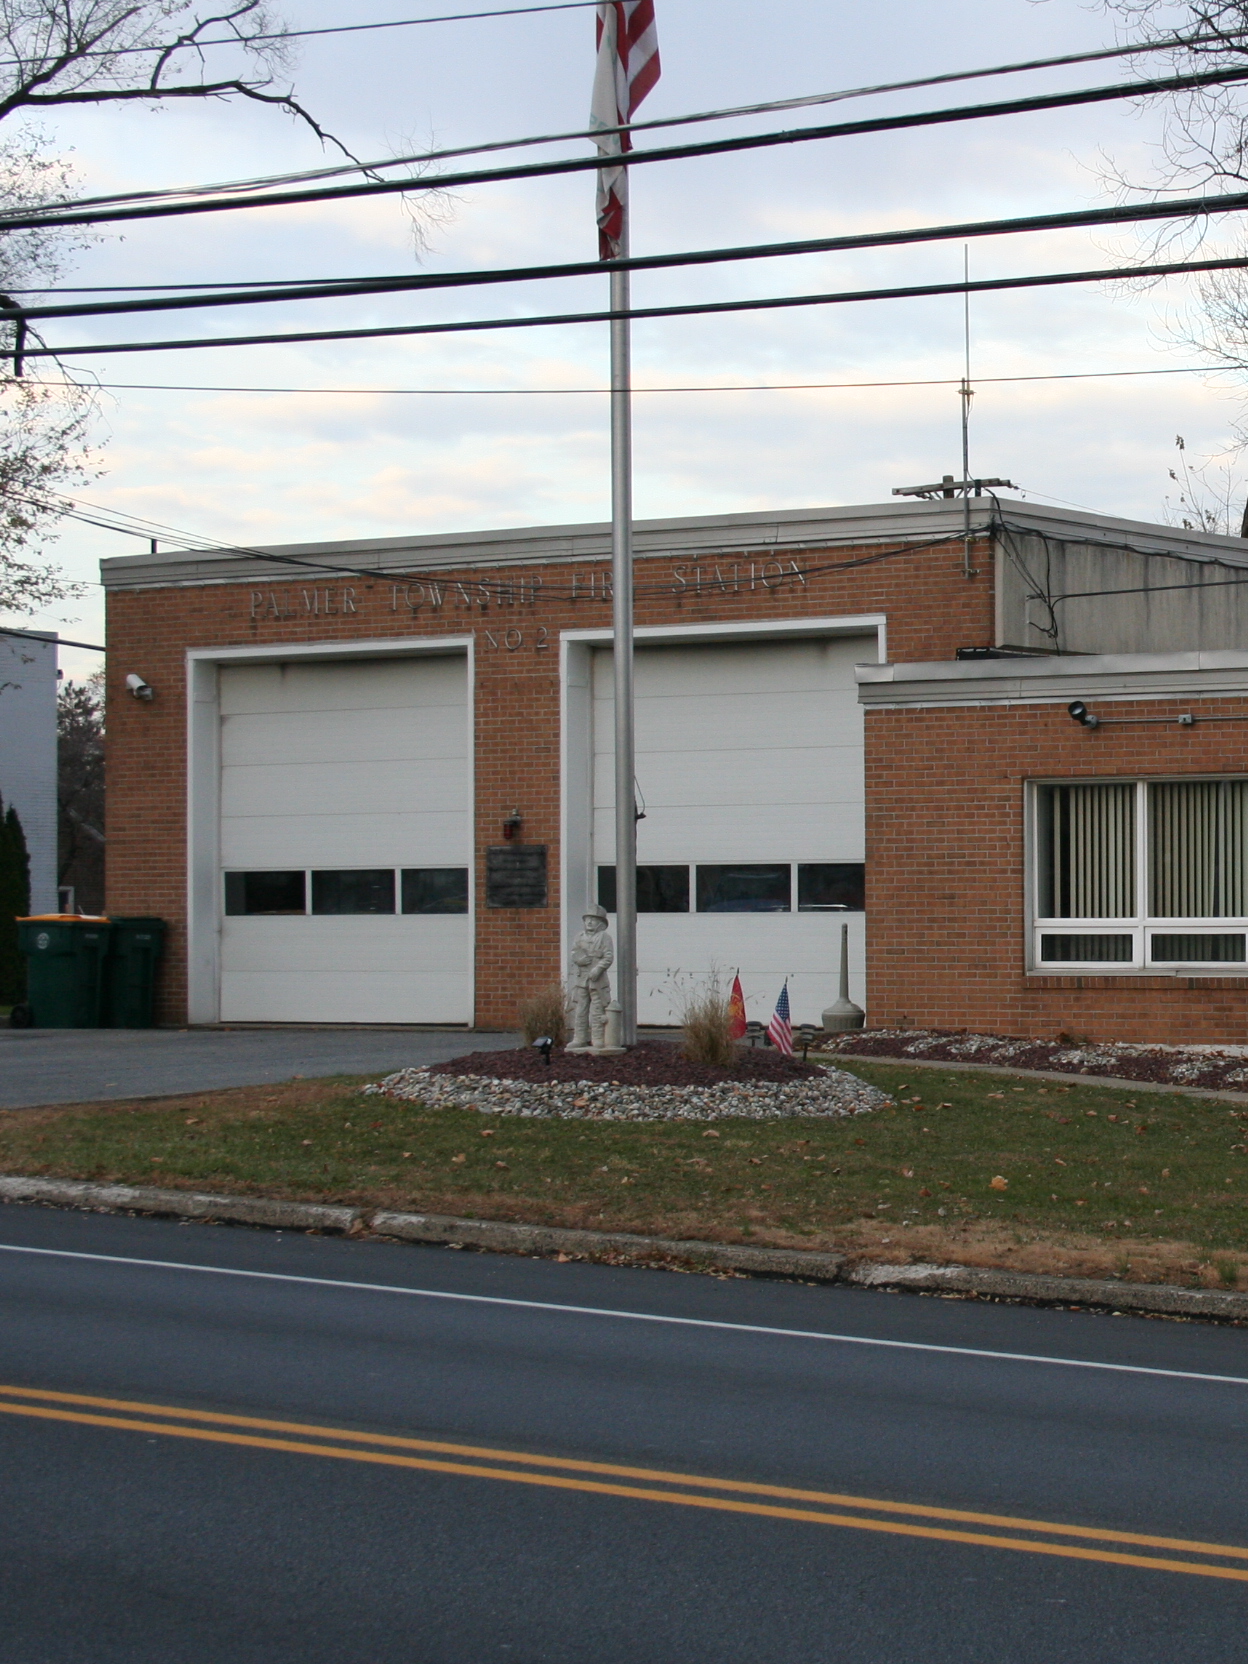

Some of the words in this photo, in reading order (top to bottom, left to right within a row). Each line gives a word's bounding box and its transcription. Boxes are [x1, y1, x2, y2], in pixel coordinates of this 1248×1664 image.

[250, 587, 358, 618] PALMER
[389, 576, 543, 611] TOWNSHIP
[572, 572, 615, 600] FIR
[672, 560, 806, 594] STATION
[485, 628, 522, 650] NO
[536, 626, 549, 649] 2
